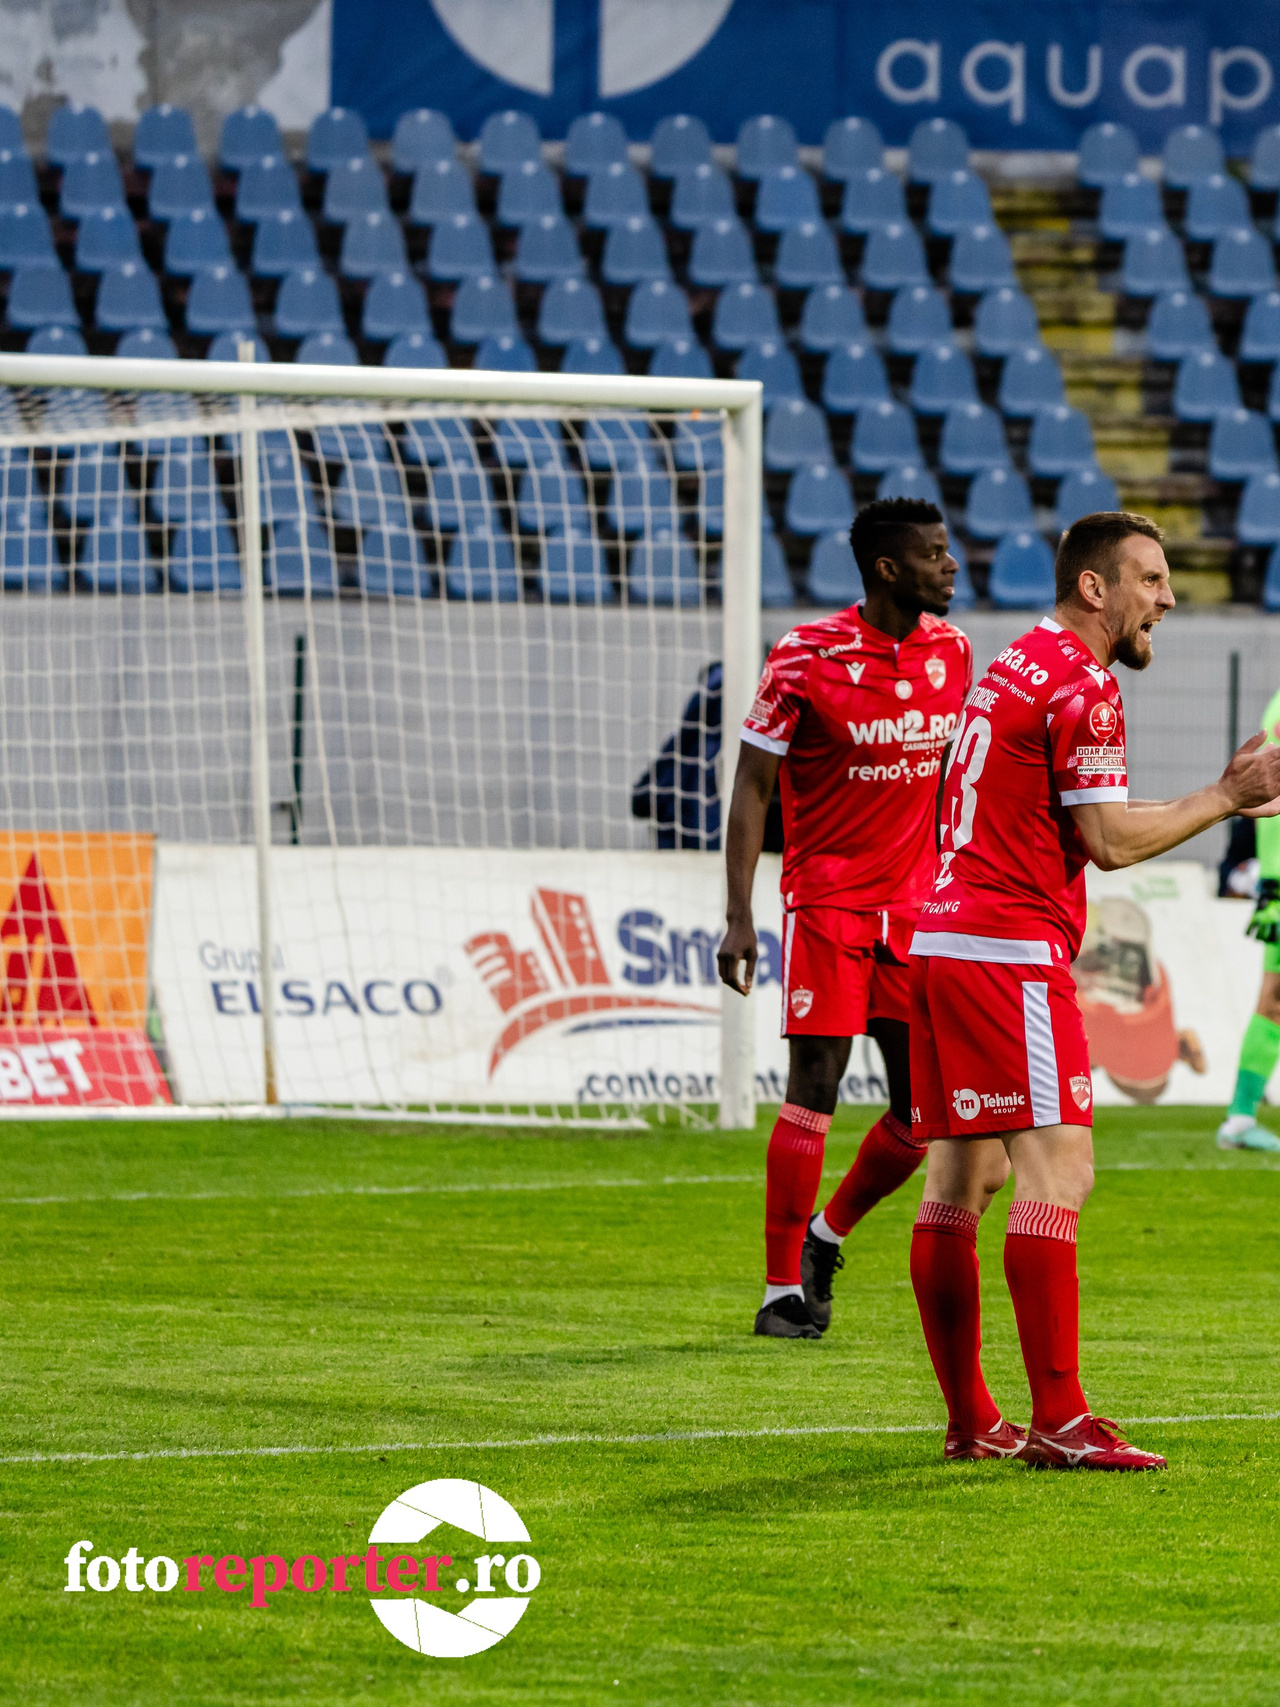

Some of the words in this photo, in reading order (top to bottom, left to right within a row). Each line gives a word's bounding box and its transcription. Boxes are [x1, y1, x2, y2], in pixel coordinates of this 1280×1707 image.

[991, 647, 1049, 685] ata.ro
[847, 709, 957, 746] WIN2.RO
[1077, 747, 1100, 756] DOAR
[617, 908, 783, 987] Sma
[210, 979, 444, 1017] ELSACO
[585, 1066, 716, 1098] contoar
[980, 1091, 1026, 1109] Tehnic
[993, 1107, 1017, 1115] GROUP
